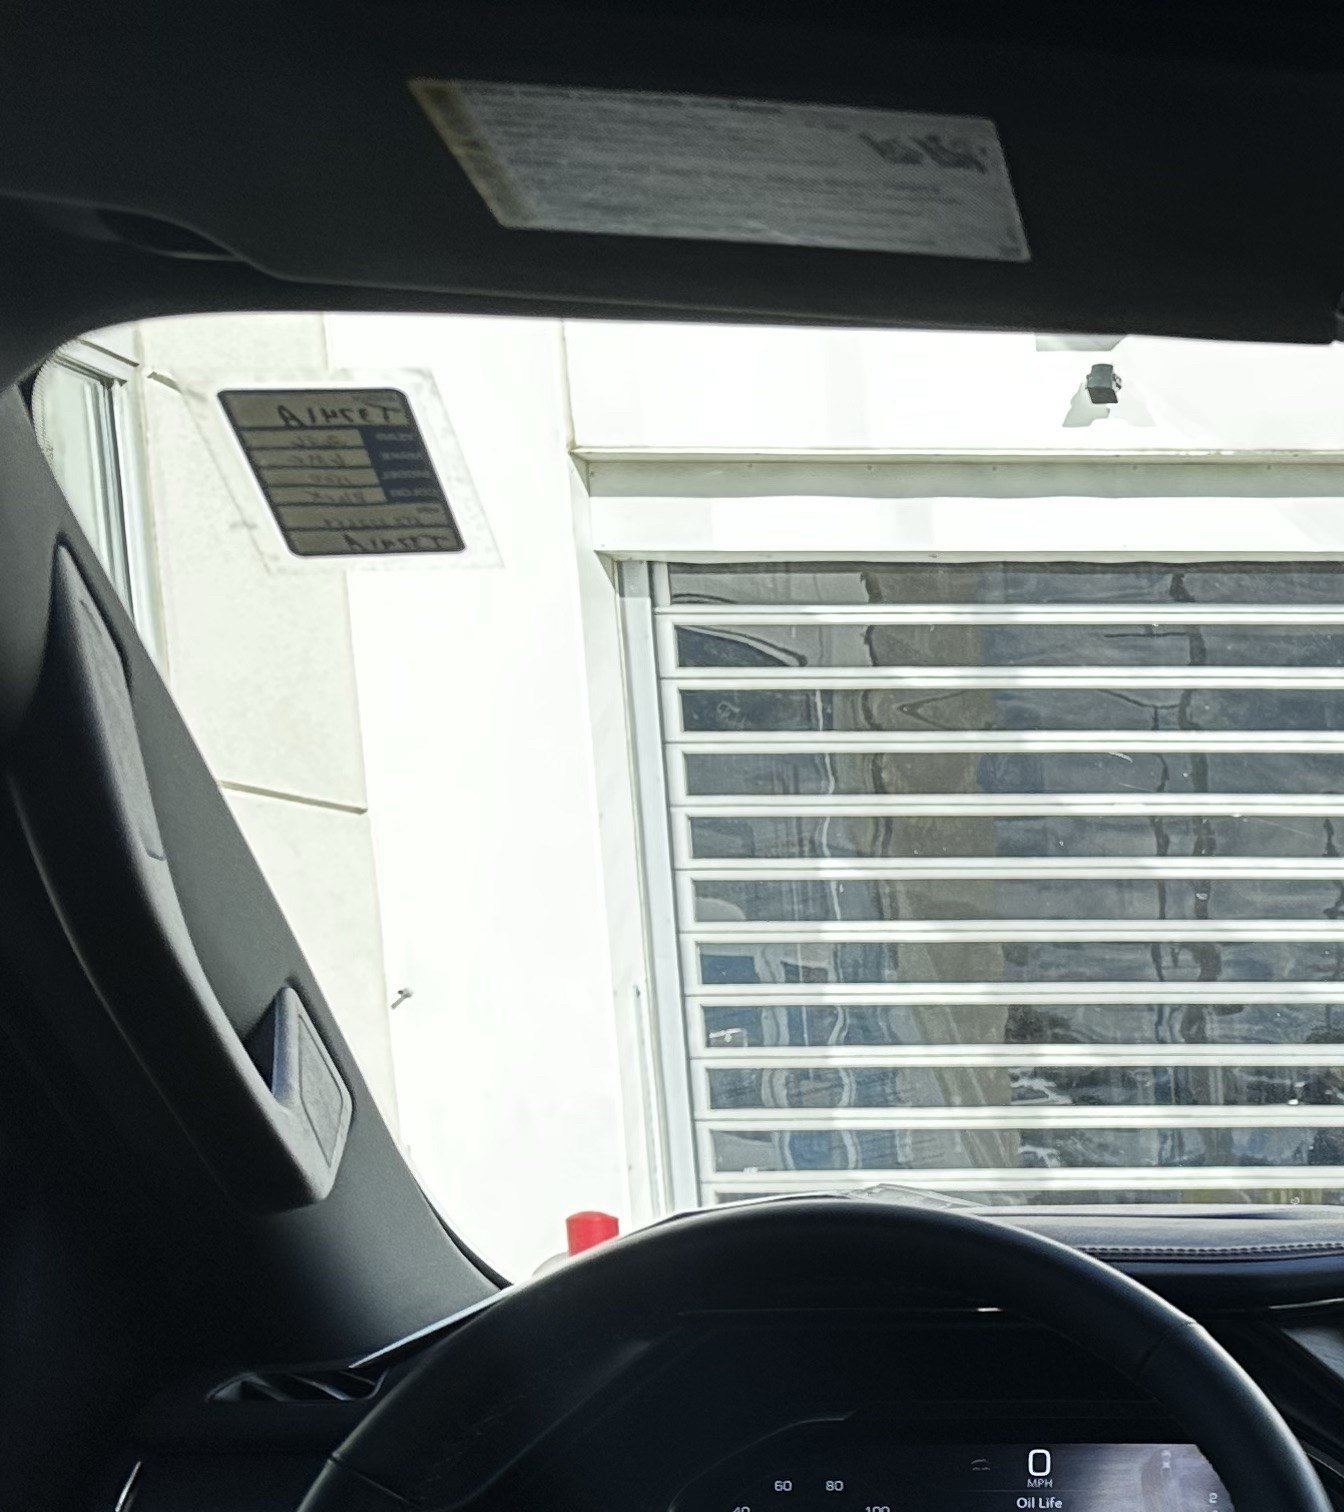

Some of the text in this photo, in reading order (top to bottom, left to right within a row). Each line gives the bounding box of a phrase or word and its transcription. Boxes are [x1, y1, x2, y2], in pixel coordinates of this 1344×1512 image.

[1028, 1449, 1052, 1477] 0
[774, 1480, 792, 1492] 60
[825, 1480, 844, 1492] 80
[1026, 1478, 1053, 1489] MPH
[1016, 1497, 1063, 1510] Oil Life
